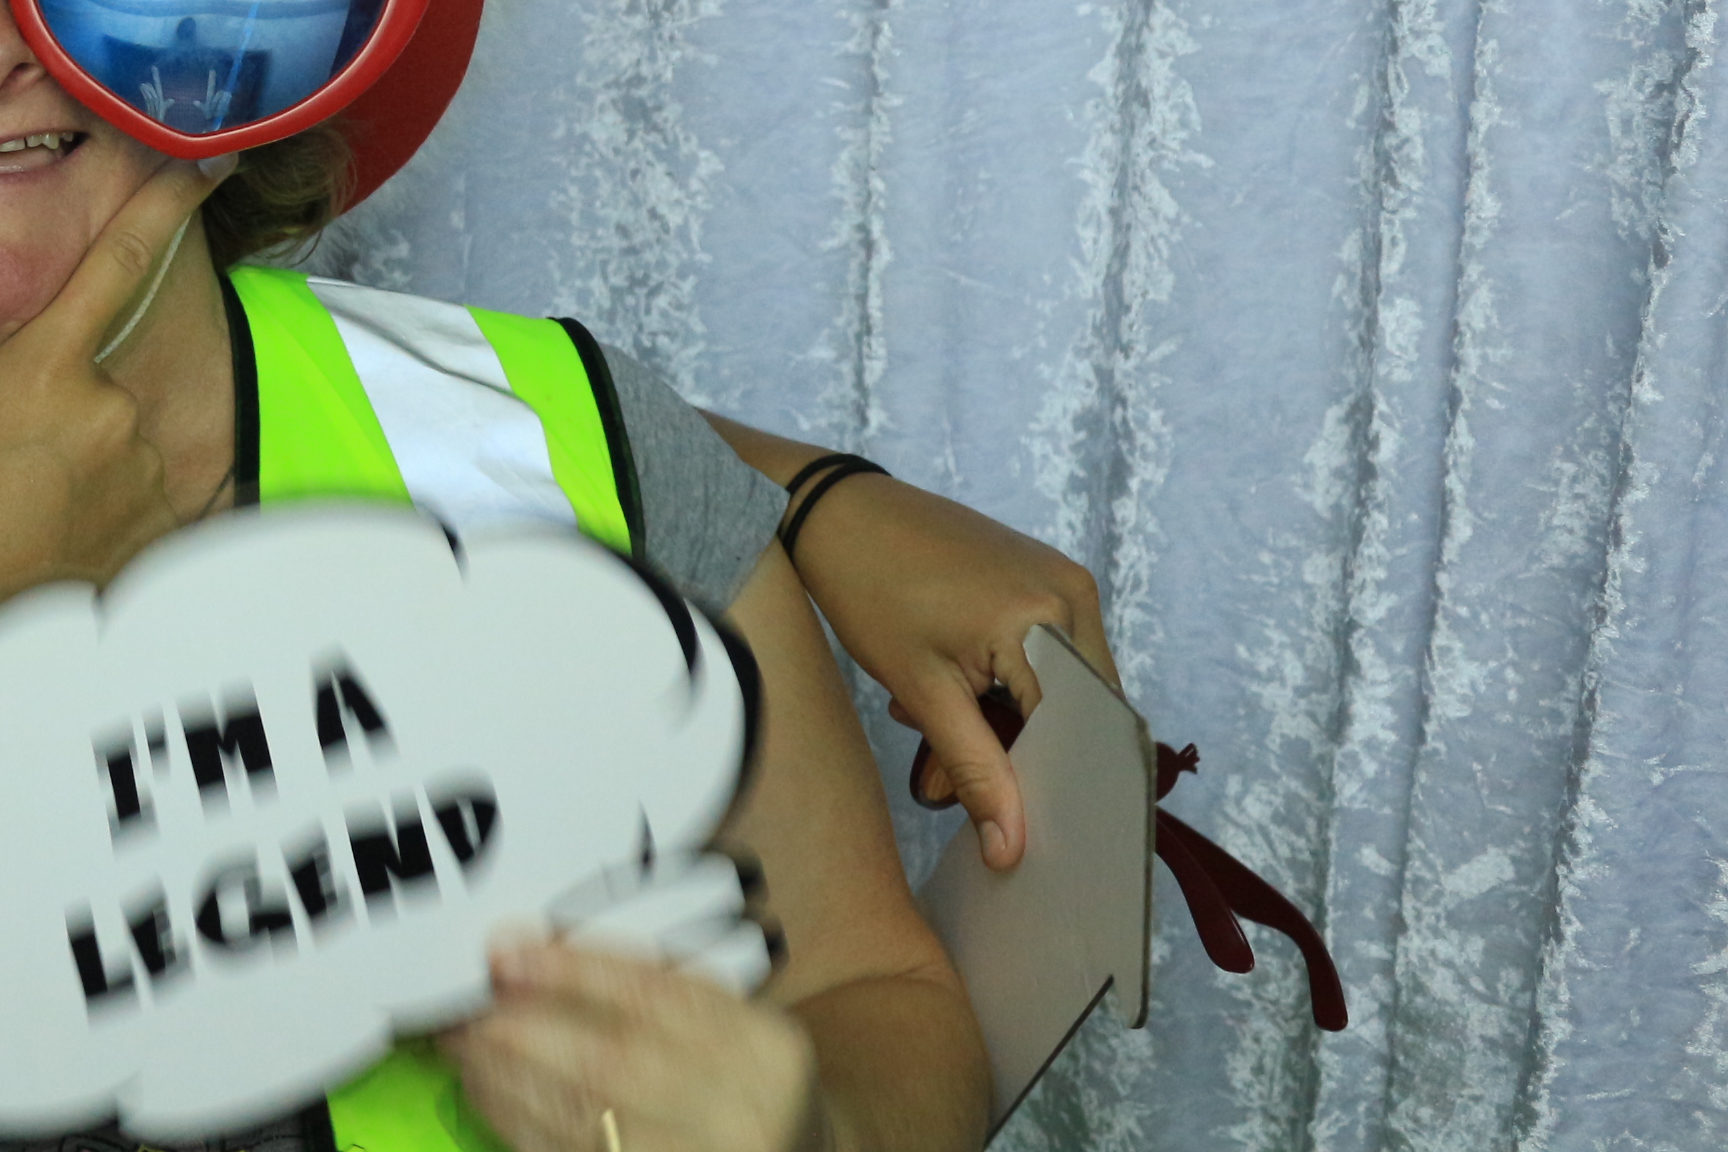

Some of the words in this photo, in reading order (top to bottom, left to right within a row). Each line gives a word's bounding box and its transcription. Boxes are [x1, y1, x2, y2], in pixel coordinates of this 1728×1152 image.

[91, 676, 279, 859] I'M
[309, 644, 400, 780] A
[65, 766, 504, 1024] LEGEND
